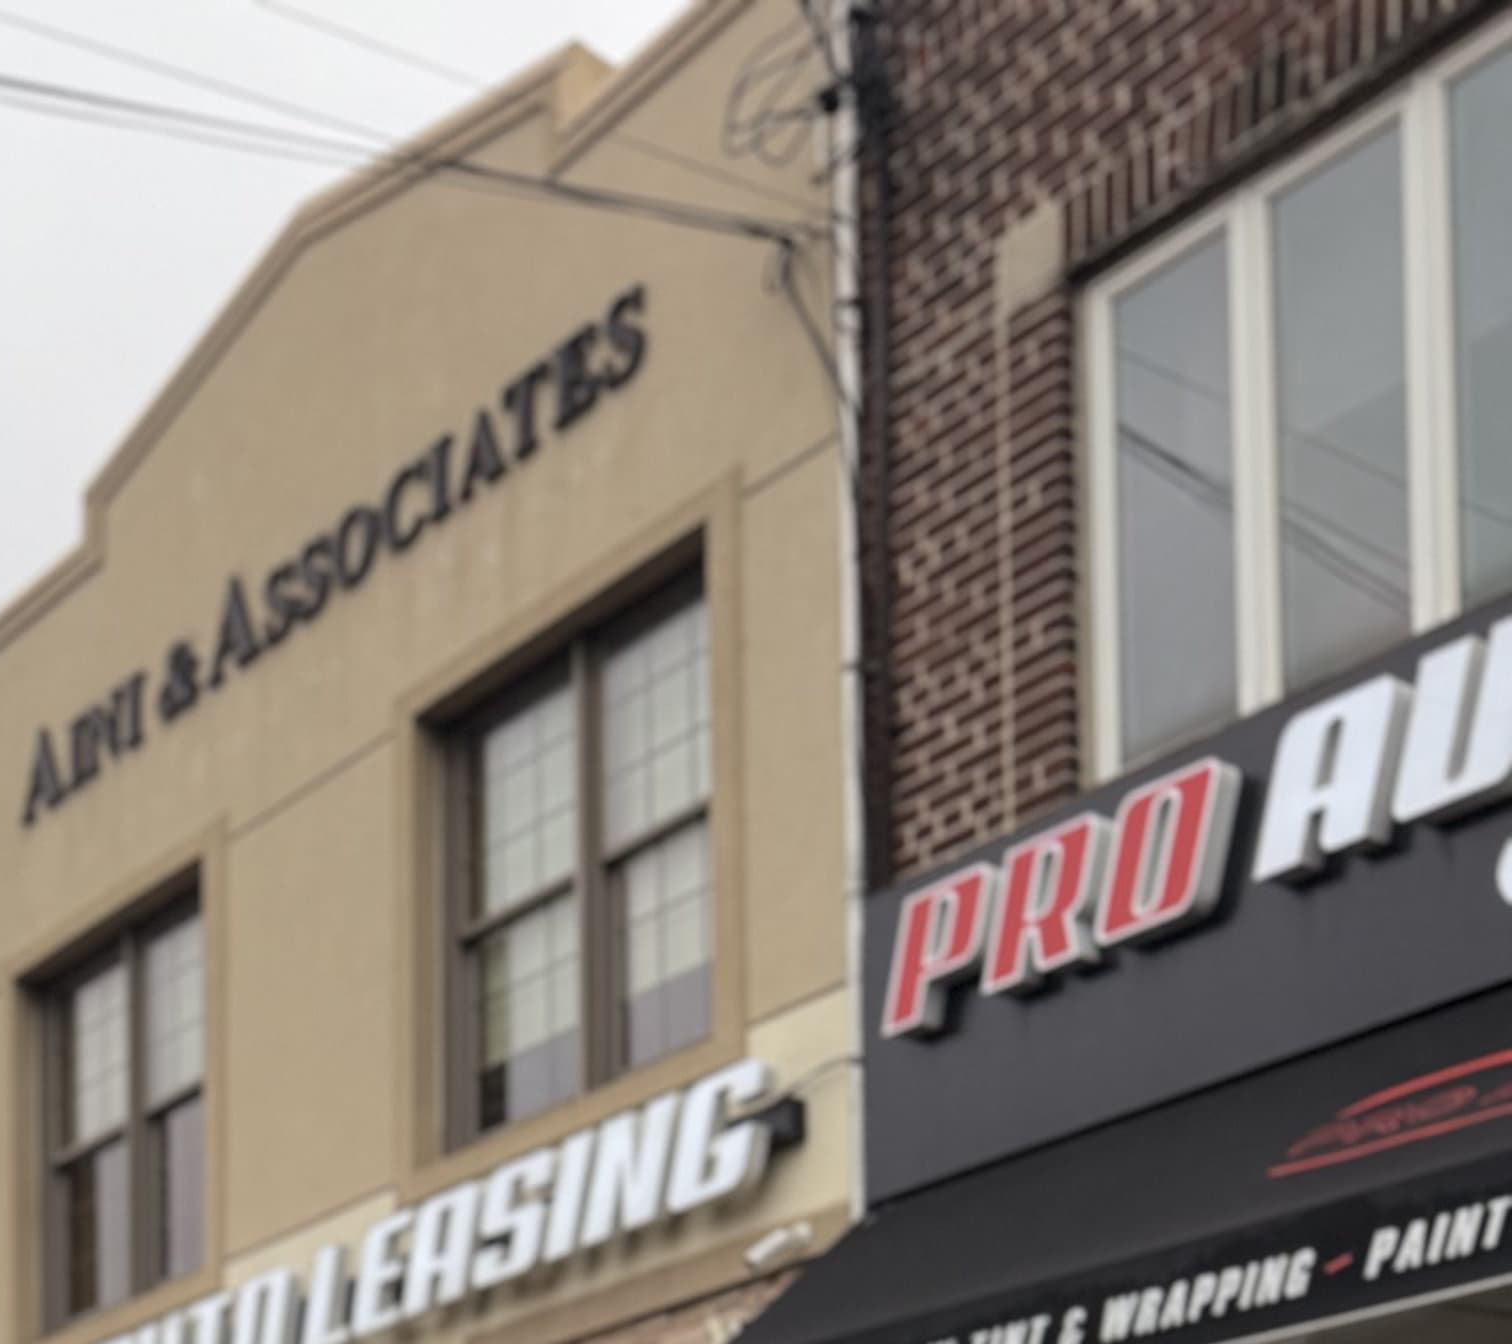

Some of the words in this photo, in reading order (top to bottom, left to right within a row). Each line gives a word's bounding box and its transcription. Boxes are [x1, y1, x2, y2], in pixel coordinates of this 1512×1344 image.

[158, 638, 199, 725] &
[882, 757, 1232, 1038] PRO
[1099, 1247, 1317, 1344] WRAPPING
[1362, 1194, 1512, 1281] PAINT
